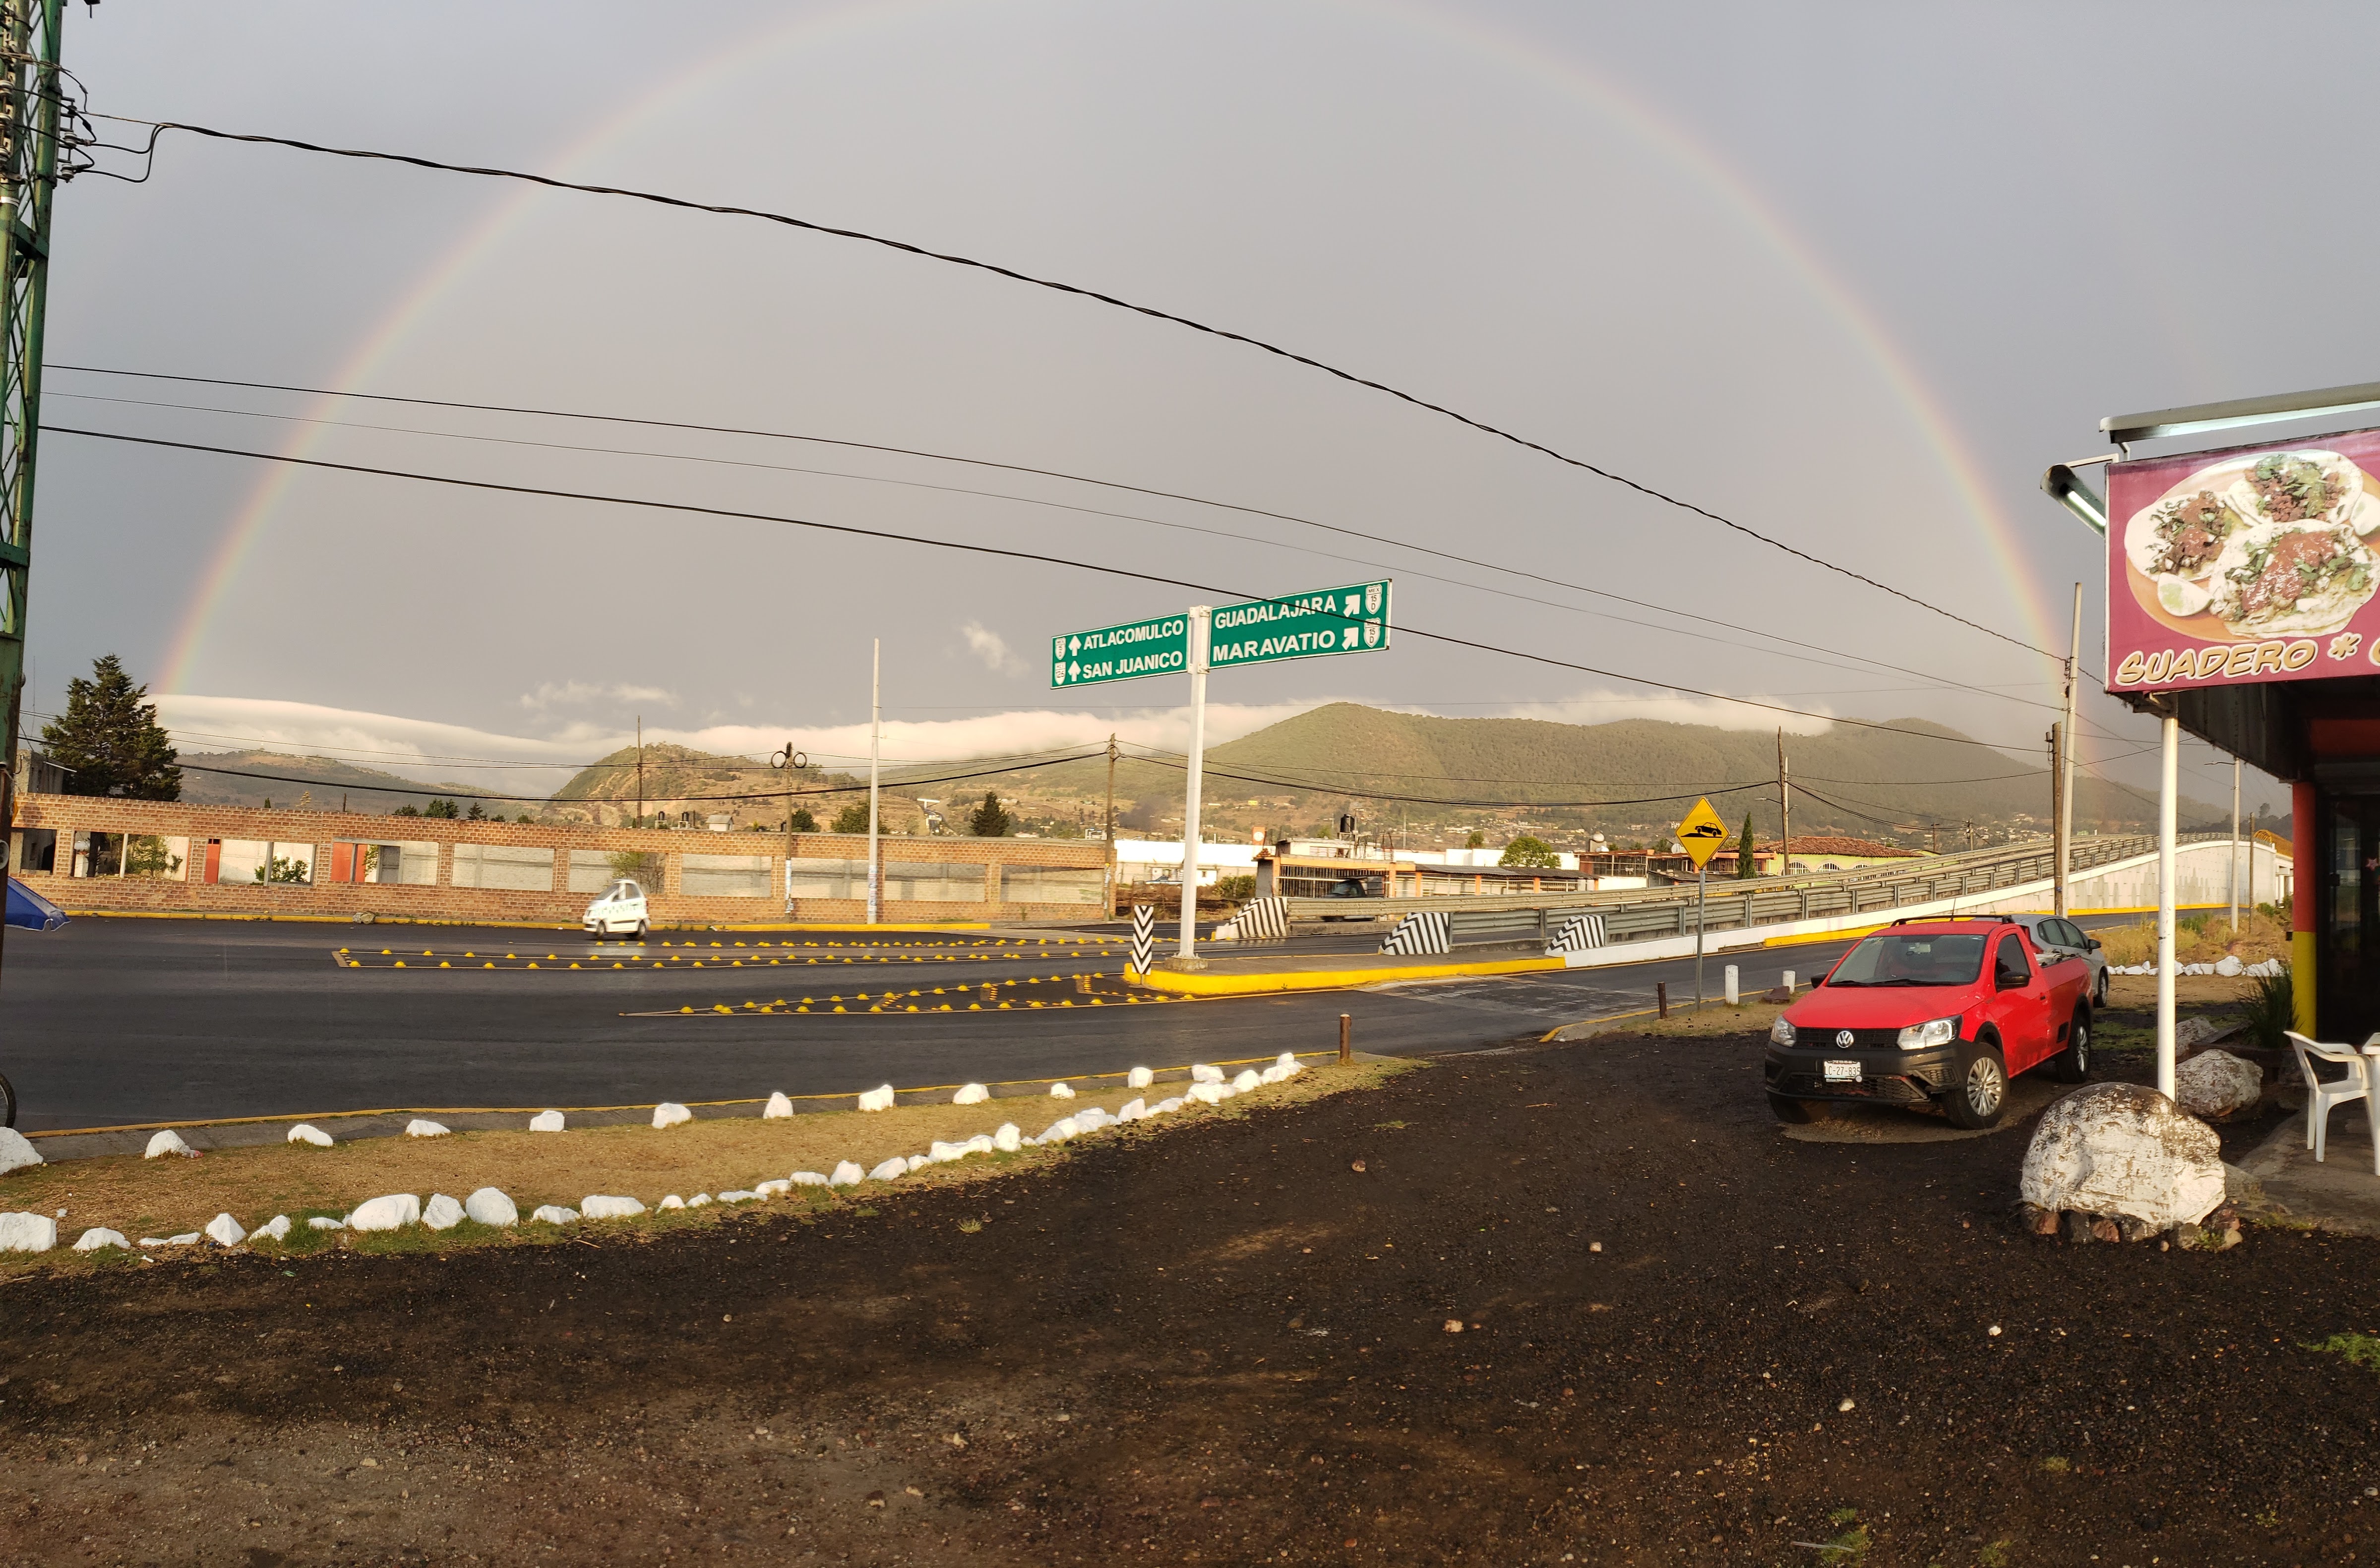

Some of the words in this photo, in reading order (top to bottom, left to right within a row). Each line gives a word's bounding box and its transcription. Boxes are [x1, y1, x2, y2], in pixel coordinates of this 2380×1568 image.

[1215, 595, 1337, 629] GUADALAJARA
[1083, 620, 1184, 650] ATLACOMULCO
[1213, 630, 1336, 662] MARAVATIO
[1083, 661, 1112, 679] SAN
[1115, 651, 1183, 674] JUANICO
[2115, 639, 2319, 686] SUADERO
